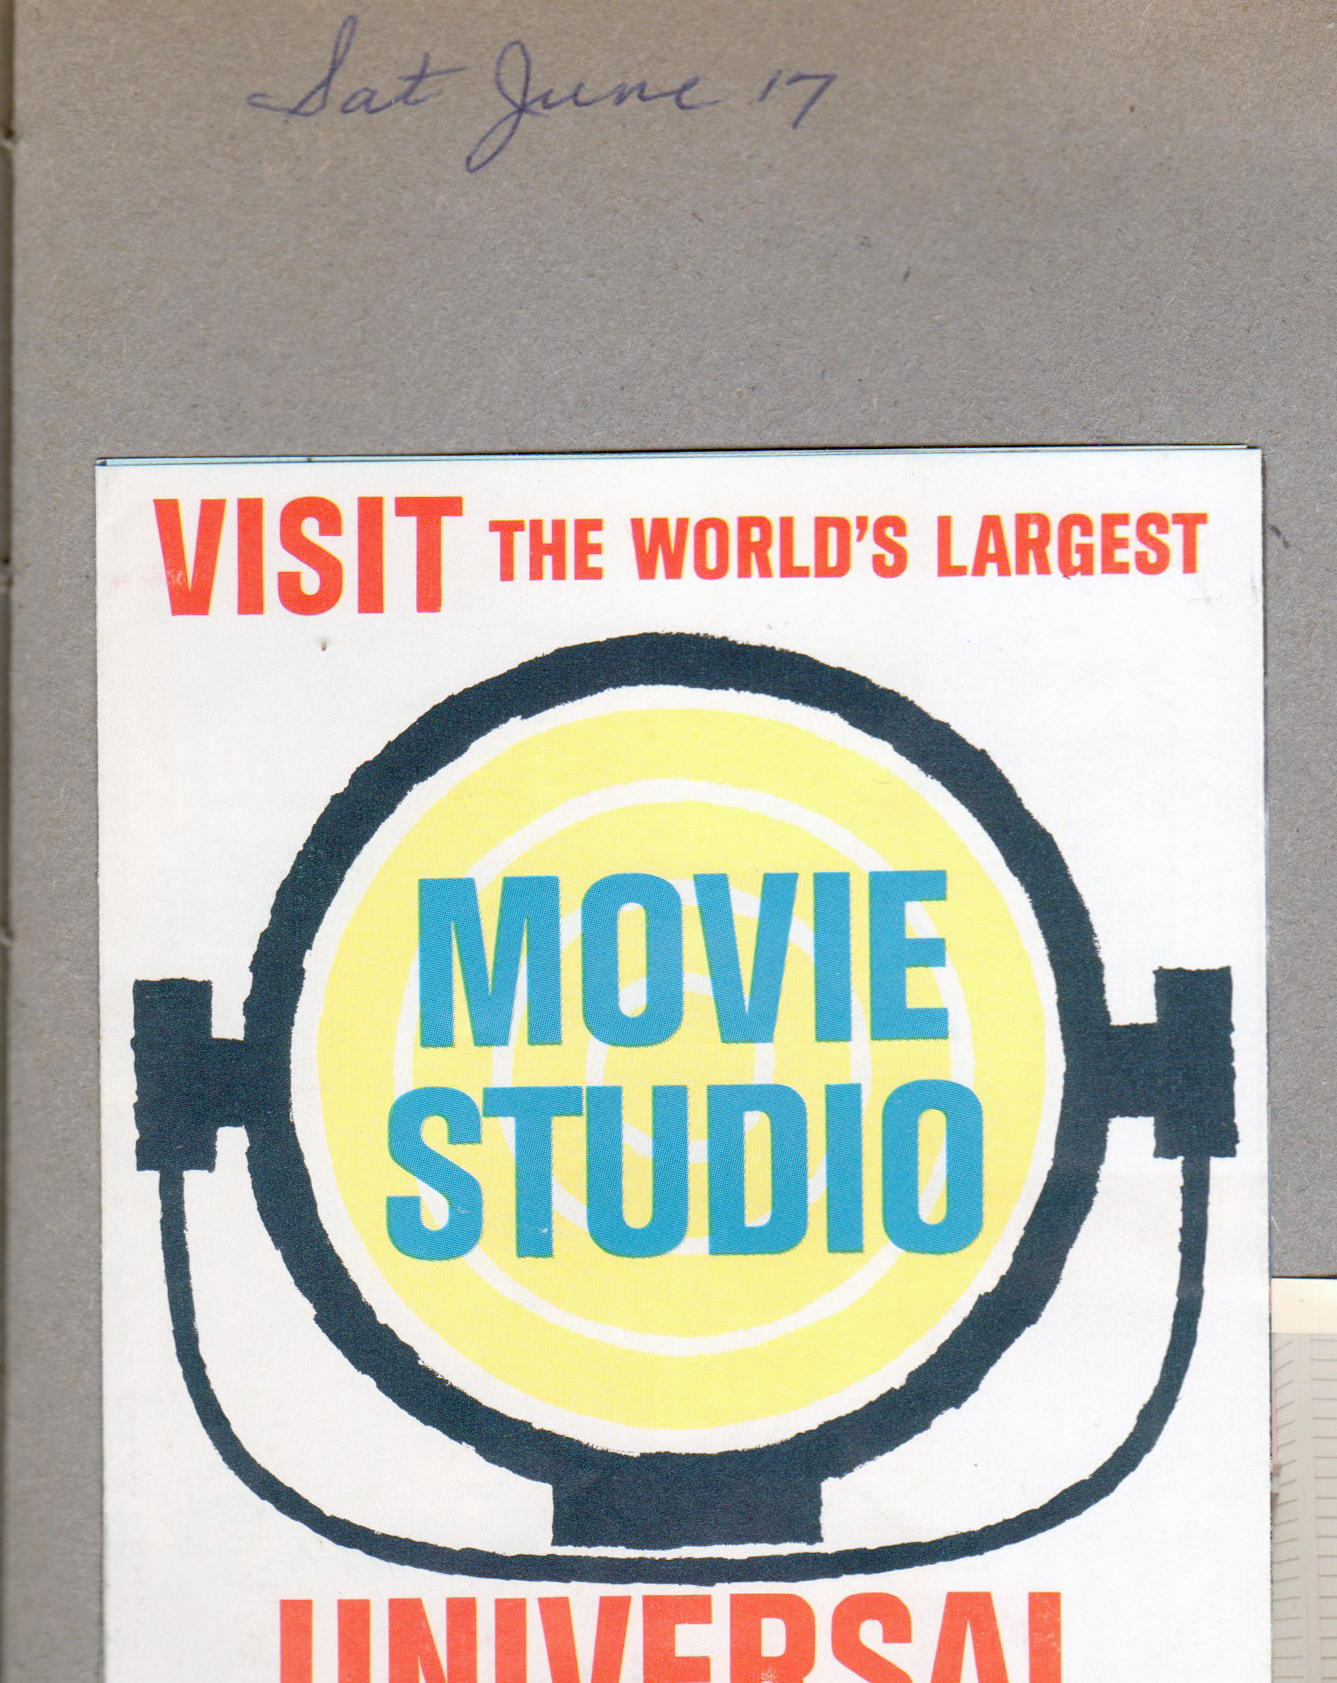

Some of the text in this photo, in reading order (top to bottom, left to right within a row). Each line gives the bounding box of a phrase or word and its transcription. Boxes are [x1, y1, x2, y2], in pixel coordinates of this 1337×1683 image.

[246, 15, 838, 173] Sat June 17
[153, 496, 1208, 616] VISIT THE WORLD'S LARGEST
[418, 868, 950, 1048] MOVIE
[386, 1078, 985, 1261] STUDIO
